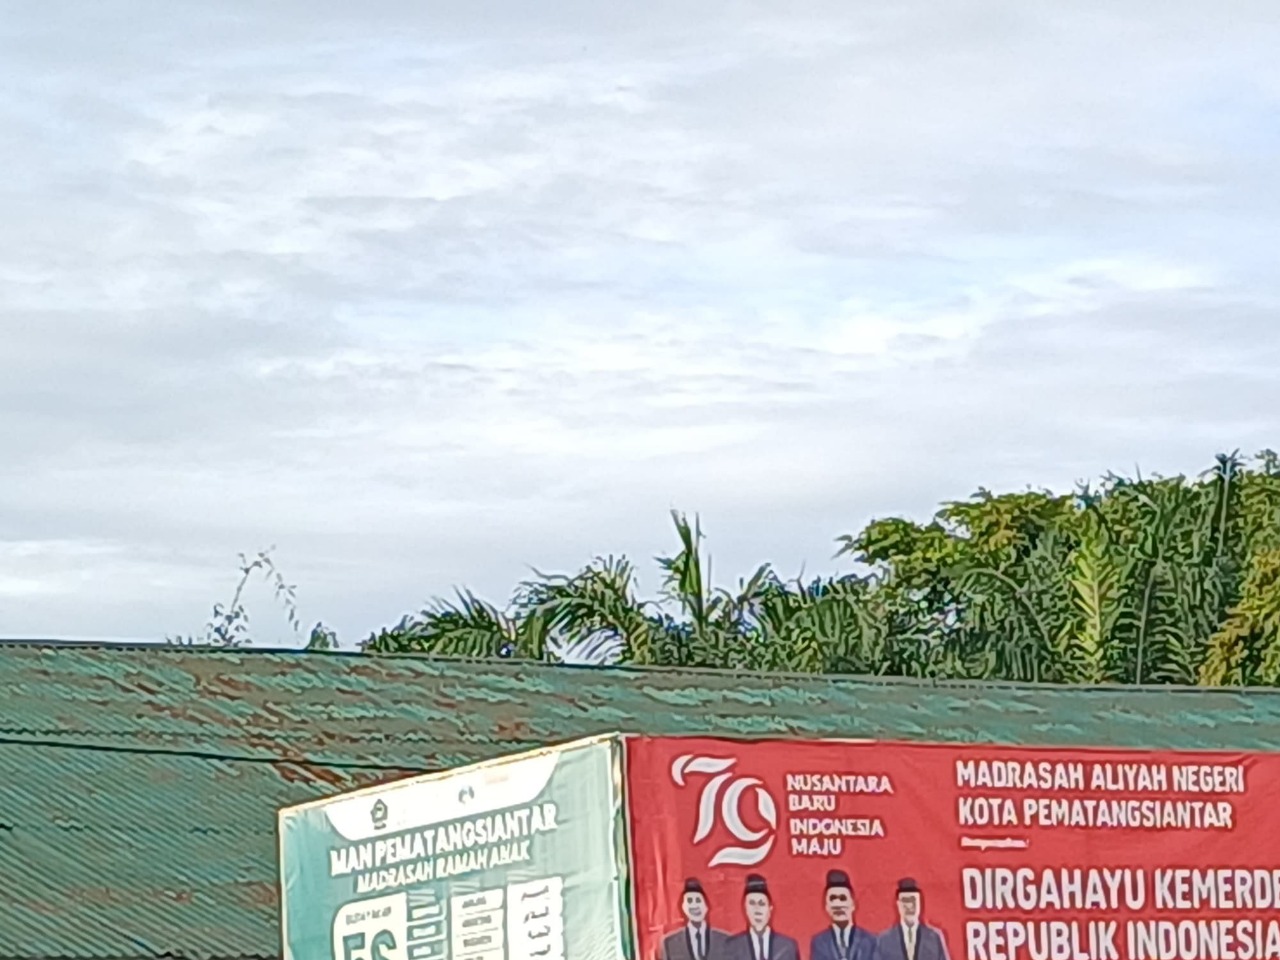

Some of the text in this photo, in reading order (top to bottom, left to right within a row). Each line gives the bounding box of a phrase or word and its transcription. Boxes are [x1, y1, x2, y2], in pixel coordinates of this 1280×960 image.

[786, 774, 894, 794] NUSANTARA
[956, 760, 1244, 793] MADRASAH ALIYAH NEGERI
[788, 795, 836, 812] BARU
[958, 797, 1233, 829] KOTA PEMATANGSIANTAR
[330, 803, 558, 877] MAN PEMATANGSIANTAR
[789, 818, 885, 837] INDONESIA
[791, 838, 842, 856] MAJU
[357, 858, 434, 894] MADRASAH
[435, 852, 488, 879] RAMAH
[489, 839, 530, 868] ANAK
[962, 867, 1146, 910] DIRGAHAYU
